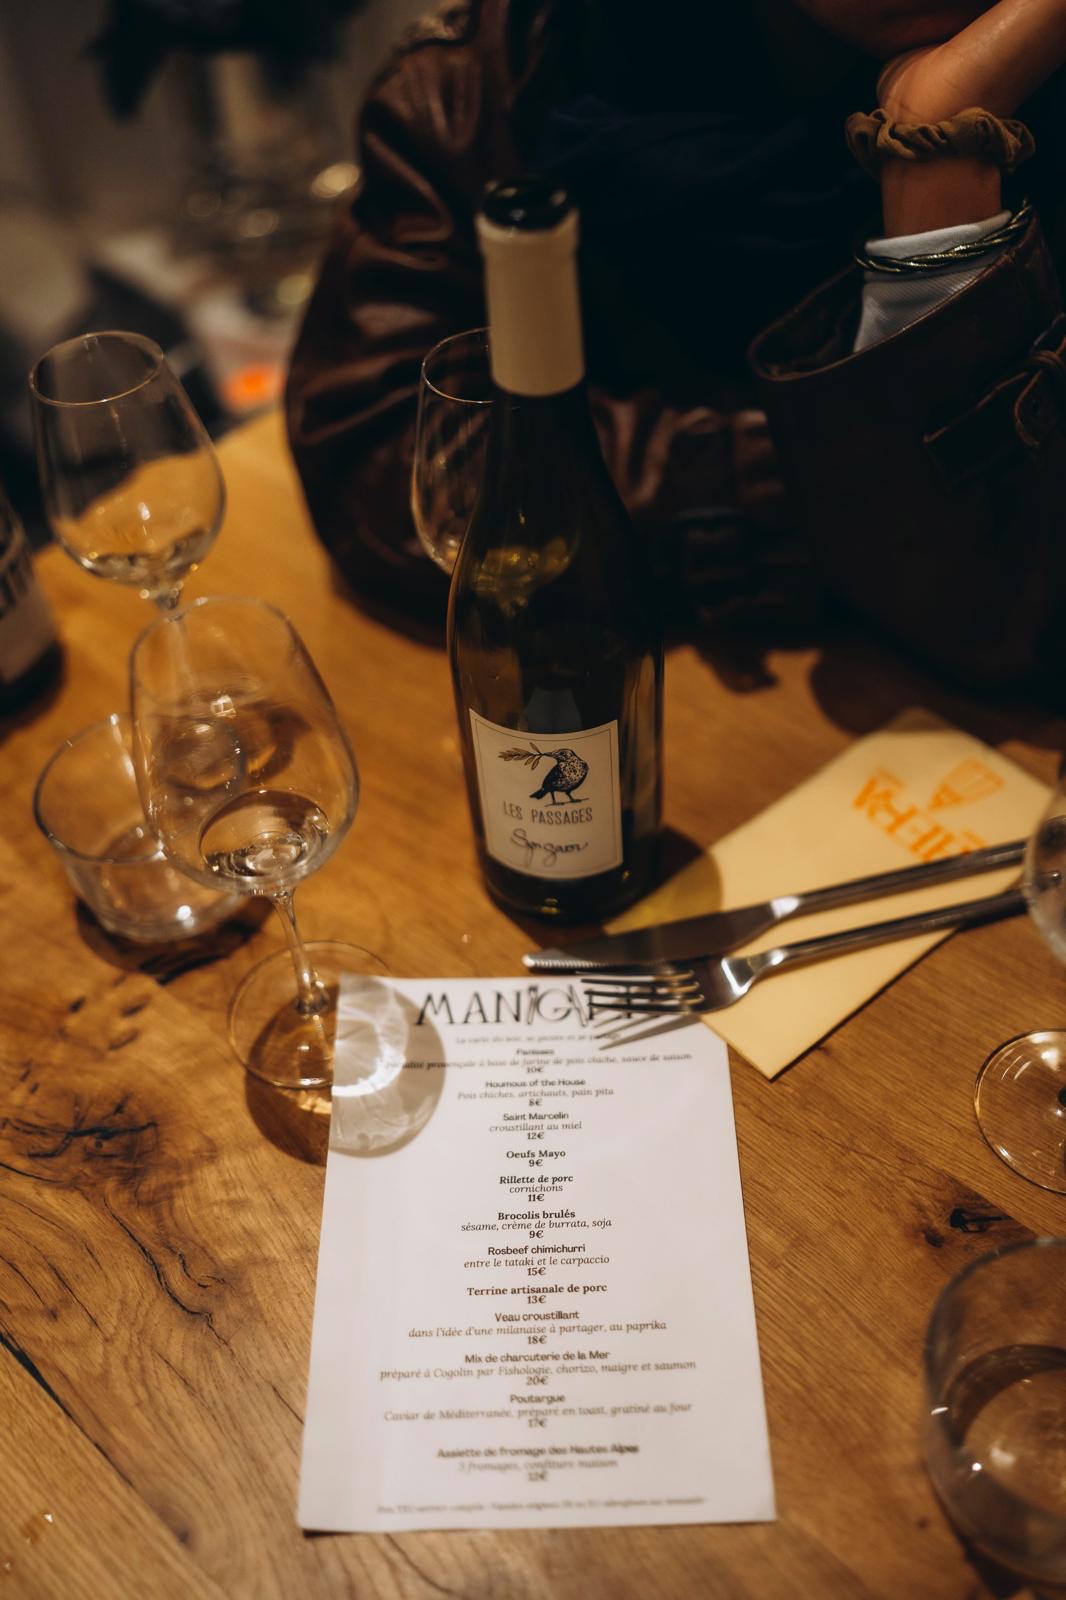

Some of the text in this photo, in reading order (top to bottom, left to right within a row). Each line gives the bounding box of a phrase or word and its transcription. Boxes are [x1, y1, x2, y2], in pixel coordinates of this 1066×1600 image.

[503, 801, 593, 825] LES PASSAGES
[416, 985, 648, 1025] MANG
[650, 1053, 659, 1061] de
[485, 1080, 527, 1088] Houmous
[457, 1091, 476, 1099] Pois
[572, 1088, 592, 1097] pain
[596, 1088, 614, 1096] pita
[503, 1112, 569, 1121] Saint Marcelin
[489, 1122, 544, 1132] croustillant
[562, 1121, 582, 1129] miel
[527, 1132, 544, 1140] 12€
[506, 1150, 566, 1160] Oeufs Mayo
[528, 1159, 543, 1167] 9€
[500, 1175, 573, 1184] Rillette de porc
[509, 1184, 563, 1194] cornichons
[528, 1194, 545, 1202] 11€
[498, 1209, 575, 1220] Brocolis brulés
[461, 1218, 612, 1231] sésame, crème de burrata, soja
[488, 1244, 586, 1255] Rosbeef chimichurri
[464, 1255, 609, 1268] entre le tataki et le carpaccio
[527, 1268, 546, 1276] 15€
[467, 1284, 607, 1296] Terrine artisanale de porc
[527, 1296, 546, 1304] 13€
[495, 1311, 580, 1322] Veau croustillant
[408, 1328, 433, 1337] dans
[496, 1325, 546, 1335] milanaise
[549, 1325, 556, 1333] à
[559, 1323, 607, 1335] partager,
[610, 1323, 622, 1331] au
[626, 1320, 667, 1334] paprika
[527, 1336, 547, 1344] 18€
[465, 1350, 610, 1363] Mix de charcuterie de la Mer
[380, 1368, 421, 1381] préparé
[424, 1368, 431, 1377] à
[477, 1368, 494, 1378] par
[641, 1362, 651, 1371] et
[654, 1360, 697, 1370] saumon
[526, 1376, 548, 1385] 20€
[510, 1394, 565, 1404] Poutargue
[423, 1410, 435, 1420] de
[562, 1408, 575, 1416] en
[653, 1404, 667, 1413] au
[484, 1448, 497, 1457] de
